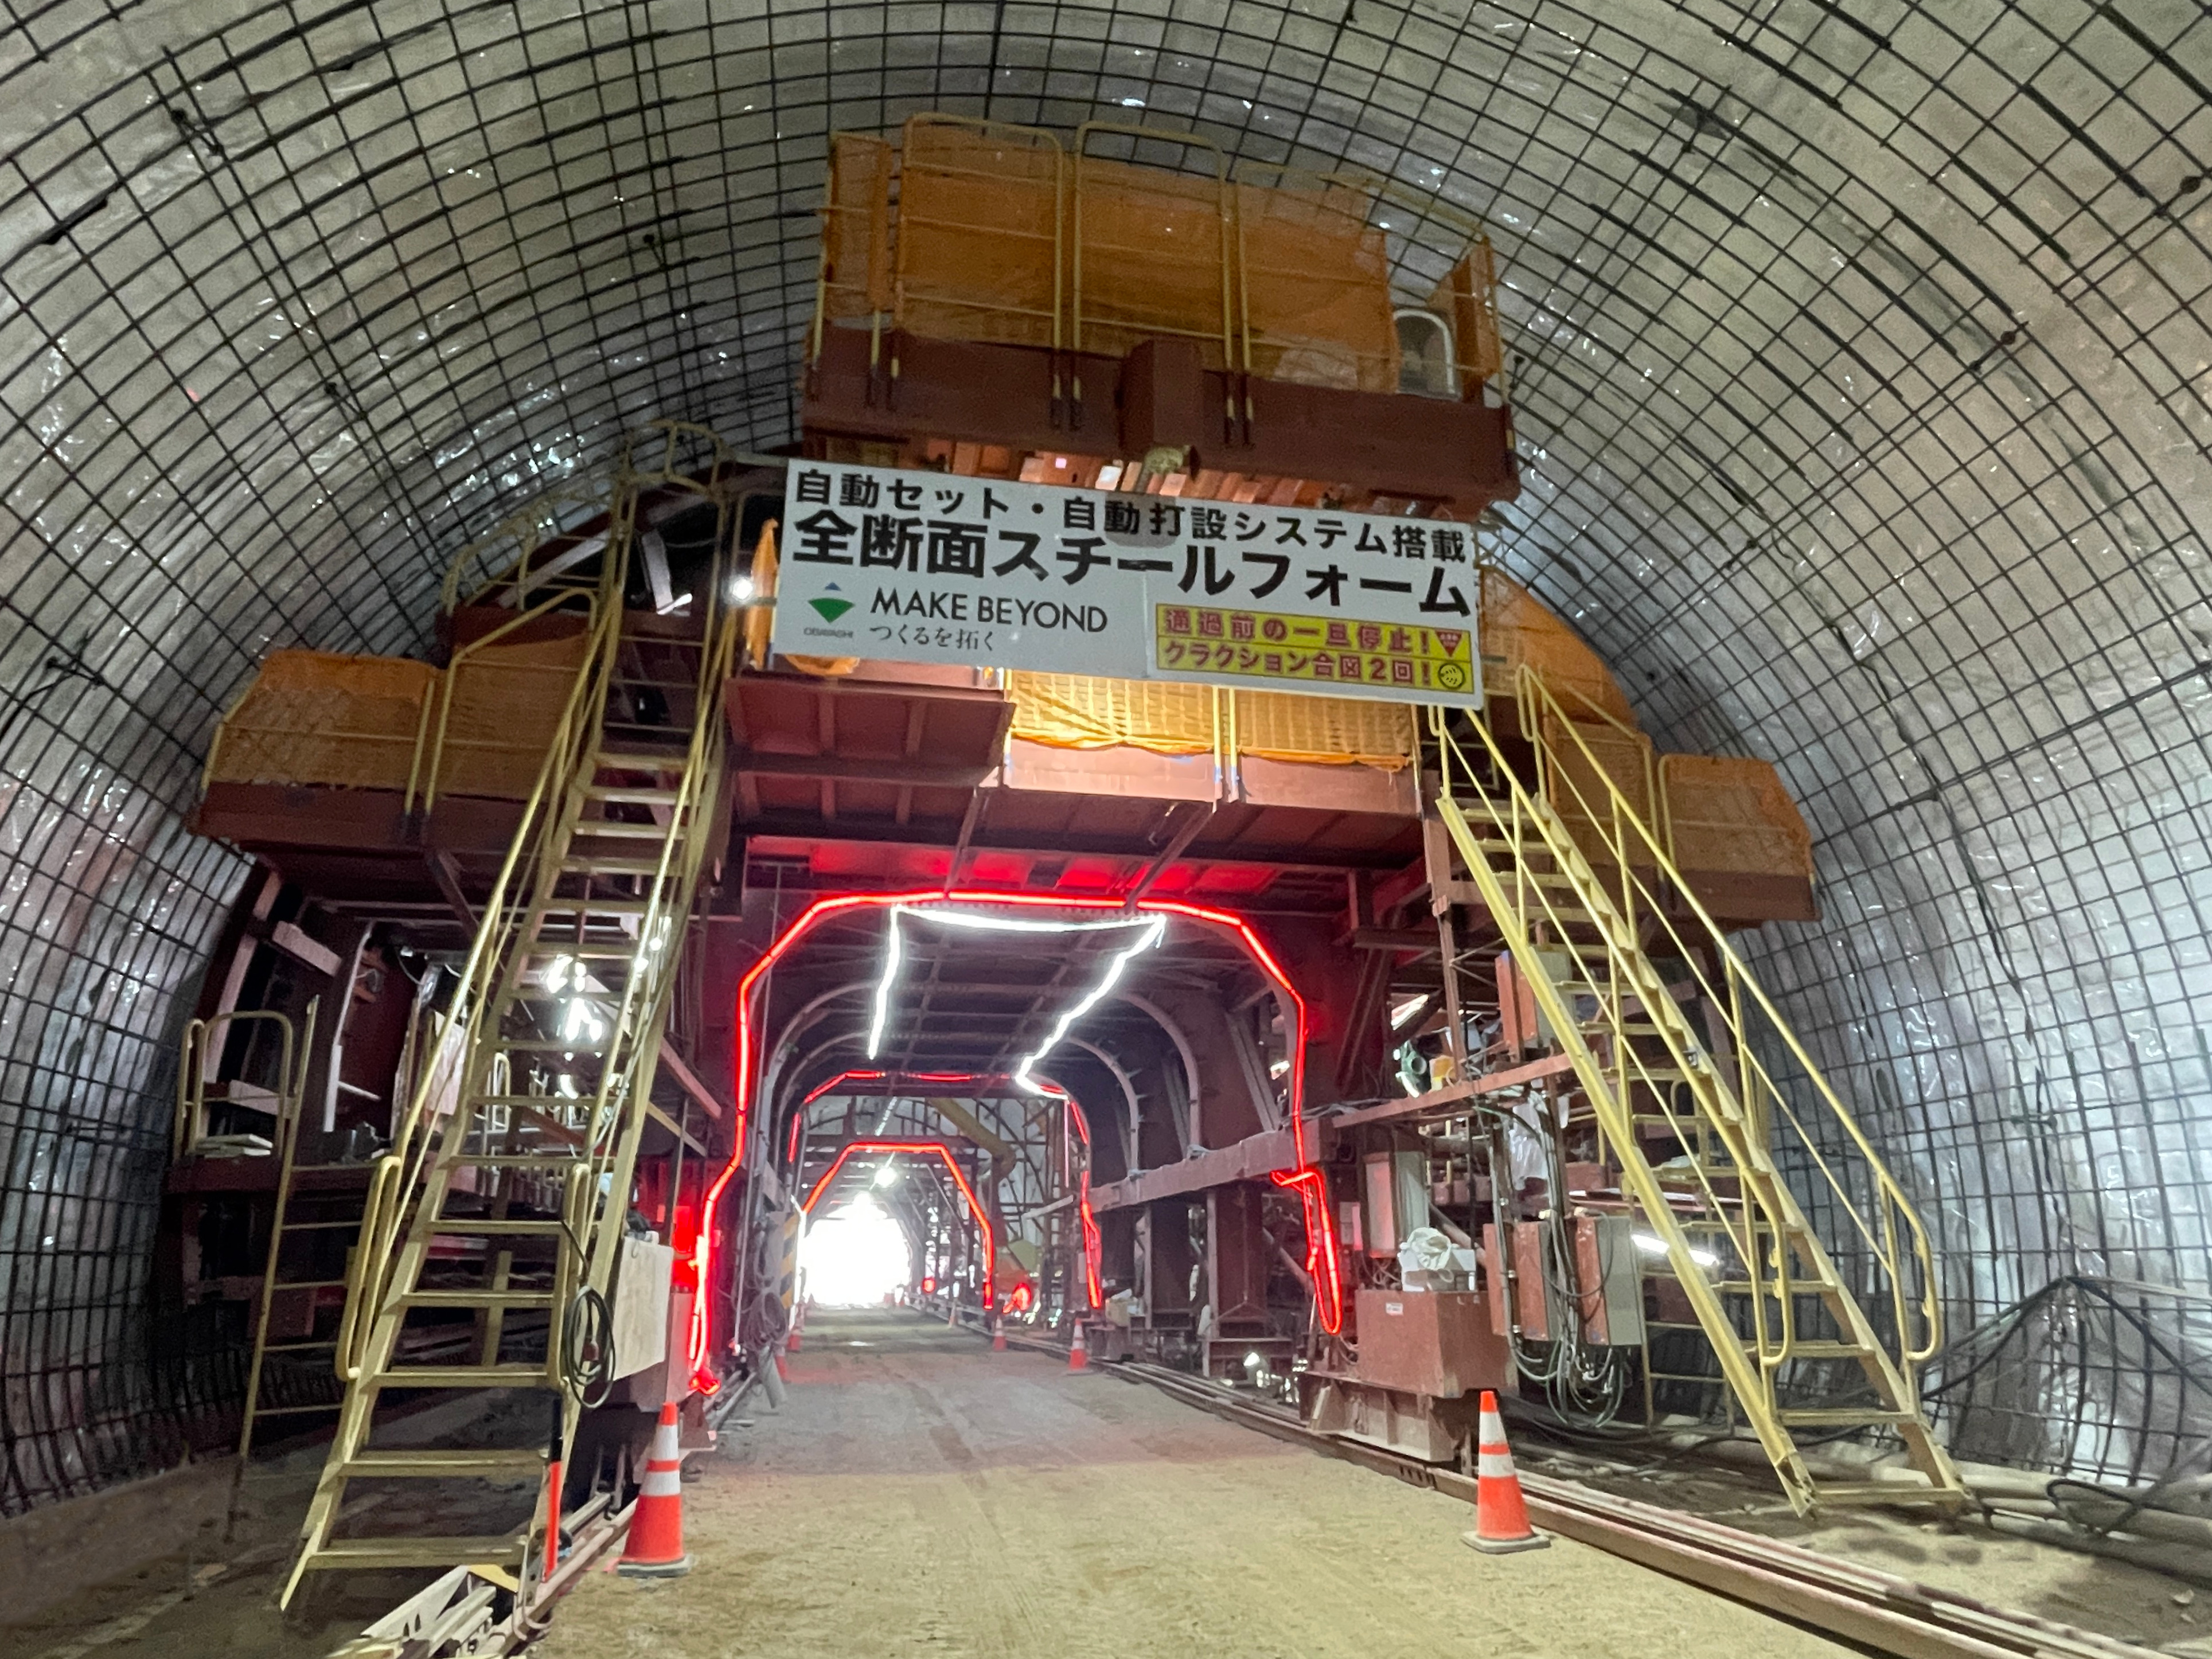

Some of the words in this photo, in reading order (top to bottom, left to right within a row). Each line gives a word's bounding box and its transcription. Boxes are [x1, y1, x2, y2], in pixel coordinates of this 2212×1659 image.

[797, 468, 1466, 564] 自動セット・自動打設システム搭載
[793, 509, 1471, 618] 全断面スチールフォーム
[869, 623, 993, 651] つくるを拓く
[870, 587, 968, 621] MAKE
[977, 595, 1107, 633] BEYOND
